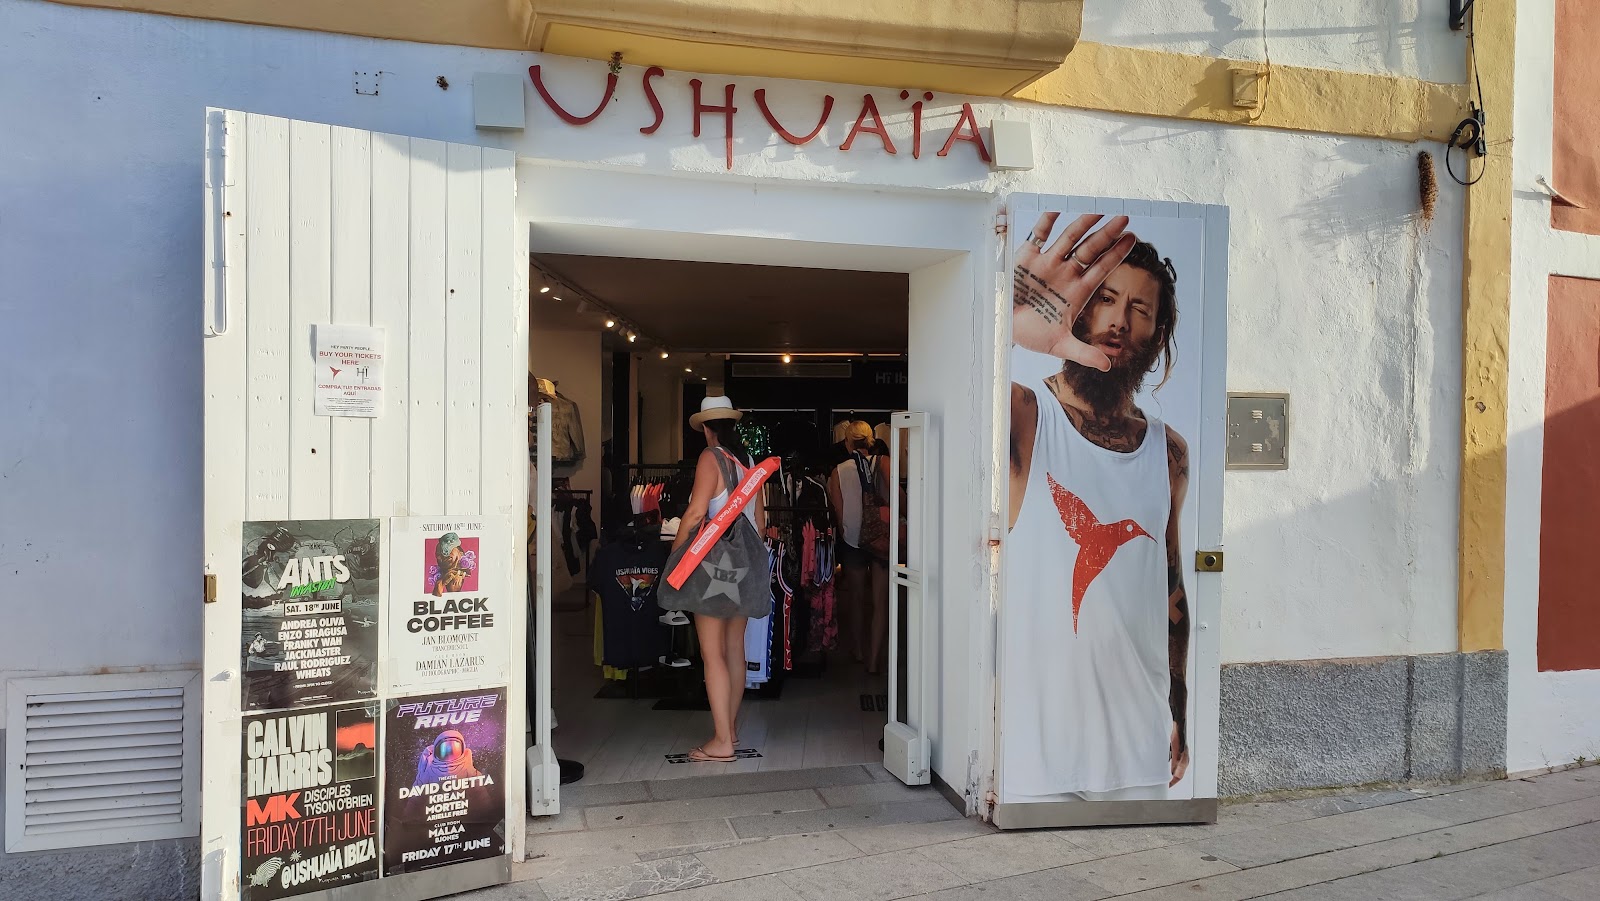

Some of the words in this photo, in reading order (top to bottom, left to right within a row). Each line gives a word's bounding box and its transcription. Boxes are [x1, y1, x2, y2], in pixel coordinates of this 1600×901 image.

[529, 65, 991, 170] USHUAÏA
[423, 523, 452, 531] SATURDAY
[277, 555, 350, 590] ANTS
[641, 566, 659, 575] VIBES
[713, 566, 738, 584] IBZ
[286, 605, 302, 613] SAT.
[321, 602, 340, 611] JUNE
[413, 597, 489, 616] BLACK
[281, 618, 317, 630] ANDREA
[319, 617, 345, 627] OLIVA
[407, 613, 494, 633] COFFEE
[278, 630, 302, 640] ENZO
[305, 627, 347, 639] SIRAGUSA
[421, 635, 436, 645] JAN
[438, 632, 479, 644] BLOMQVIST
[284, 639, 319, 651] FRANKY
[321, 637, 342, 647] WAH
[285, 647, 341, 660] JACKMASTER
[274, 661, 298, 672] RAUL
[301, 656, 350, 670] RODRIGUEZ
[416, 659, 448, 671] DAMIAN
[450, 656, 484, 668] LAZARUS
[296, 668, 331, 679] WHEATS
[397, 694, 498, 718] FUTURE
[414, 709, 482, 729] RAVE
[247, 712, 328, 759] CALVIN
[247, 748, 332, 797] HARRIS
[304, 784, 351, 803] DISCIPLES
[399, 783, 440, 800] DAVID
[442, 774, 494, 792] GUETTA
[304, 799, 335, 816] TYSON
[337, 794, 373, 811] O'BRIEN
[429, 790, 465, 804] KREAM
[247, 792, 301, 826] MK
[426, 800, 469, 815] MORTEN
[427, 811, 451, 821] ARIELLE
[453, 809, 468, 817] FREE
[247, 821, 298, 857] FRIDAY
[301, 815, 335, 848] 17TH
[338, 808, 376, 839] JUNE
[429, 824, 465, 838] MALAA
[435, 834, 459, 843] BJONES
[343, 837, 377, 868] IBIZA
[402, 846, 441, 863] FRIDAY
[443, 842, 462, 856] 17TH
[463, 837, 491, 851] JUNE
